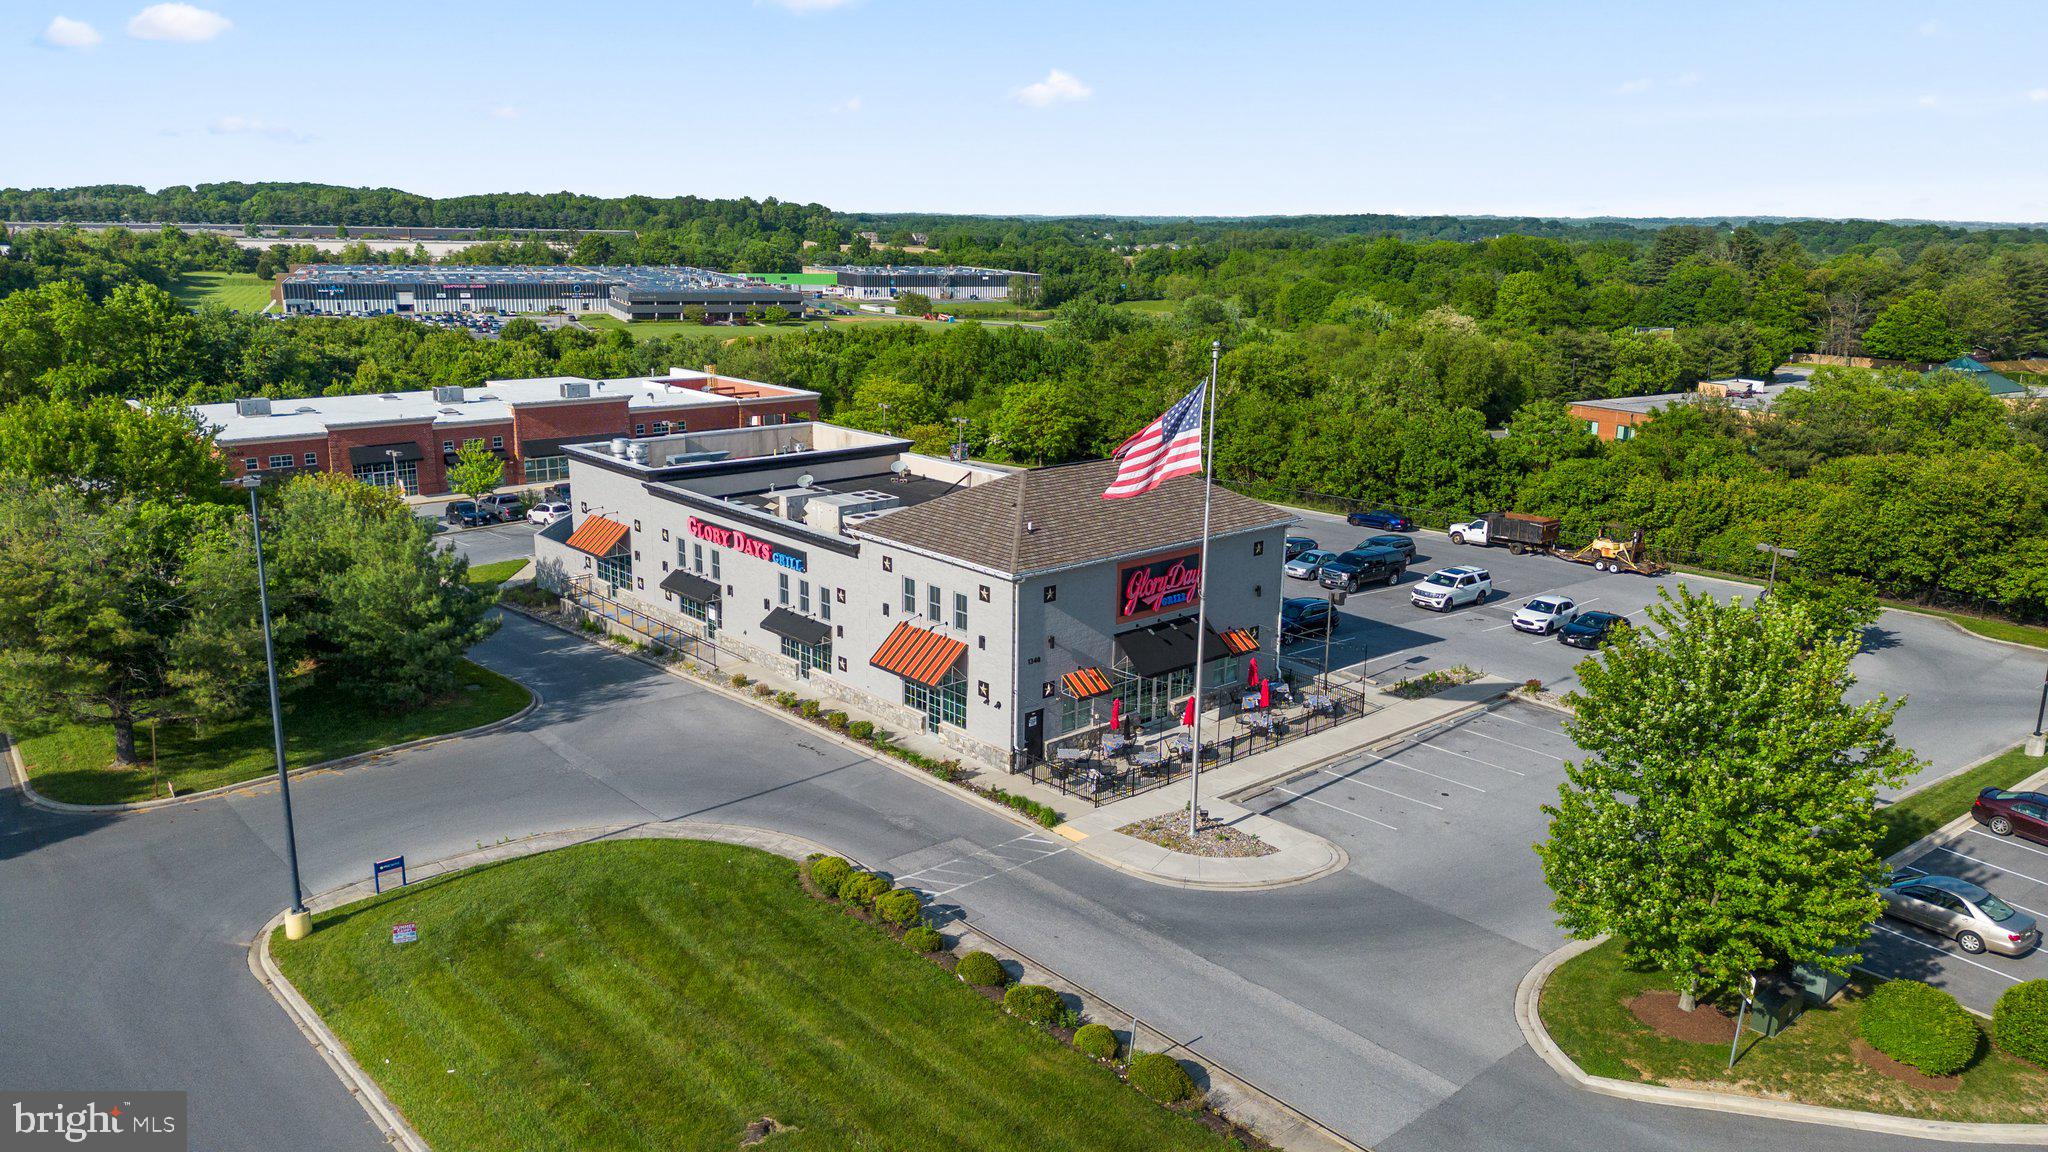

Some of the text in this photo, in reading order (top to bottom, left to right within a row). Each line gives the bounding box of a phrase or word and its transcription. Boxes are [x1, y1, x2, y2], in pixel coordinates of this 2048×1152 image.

[687, 516, 804, 572] GLORY DAYS GRILL
[1124, 560, 1204, 616] Glory Day
